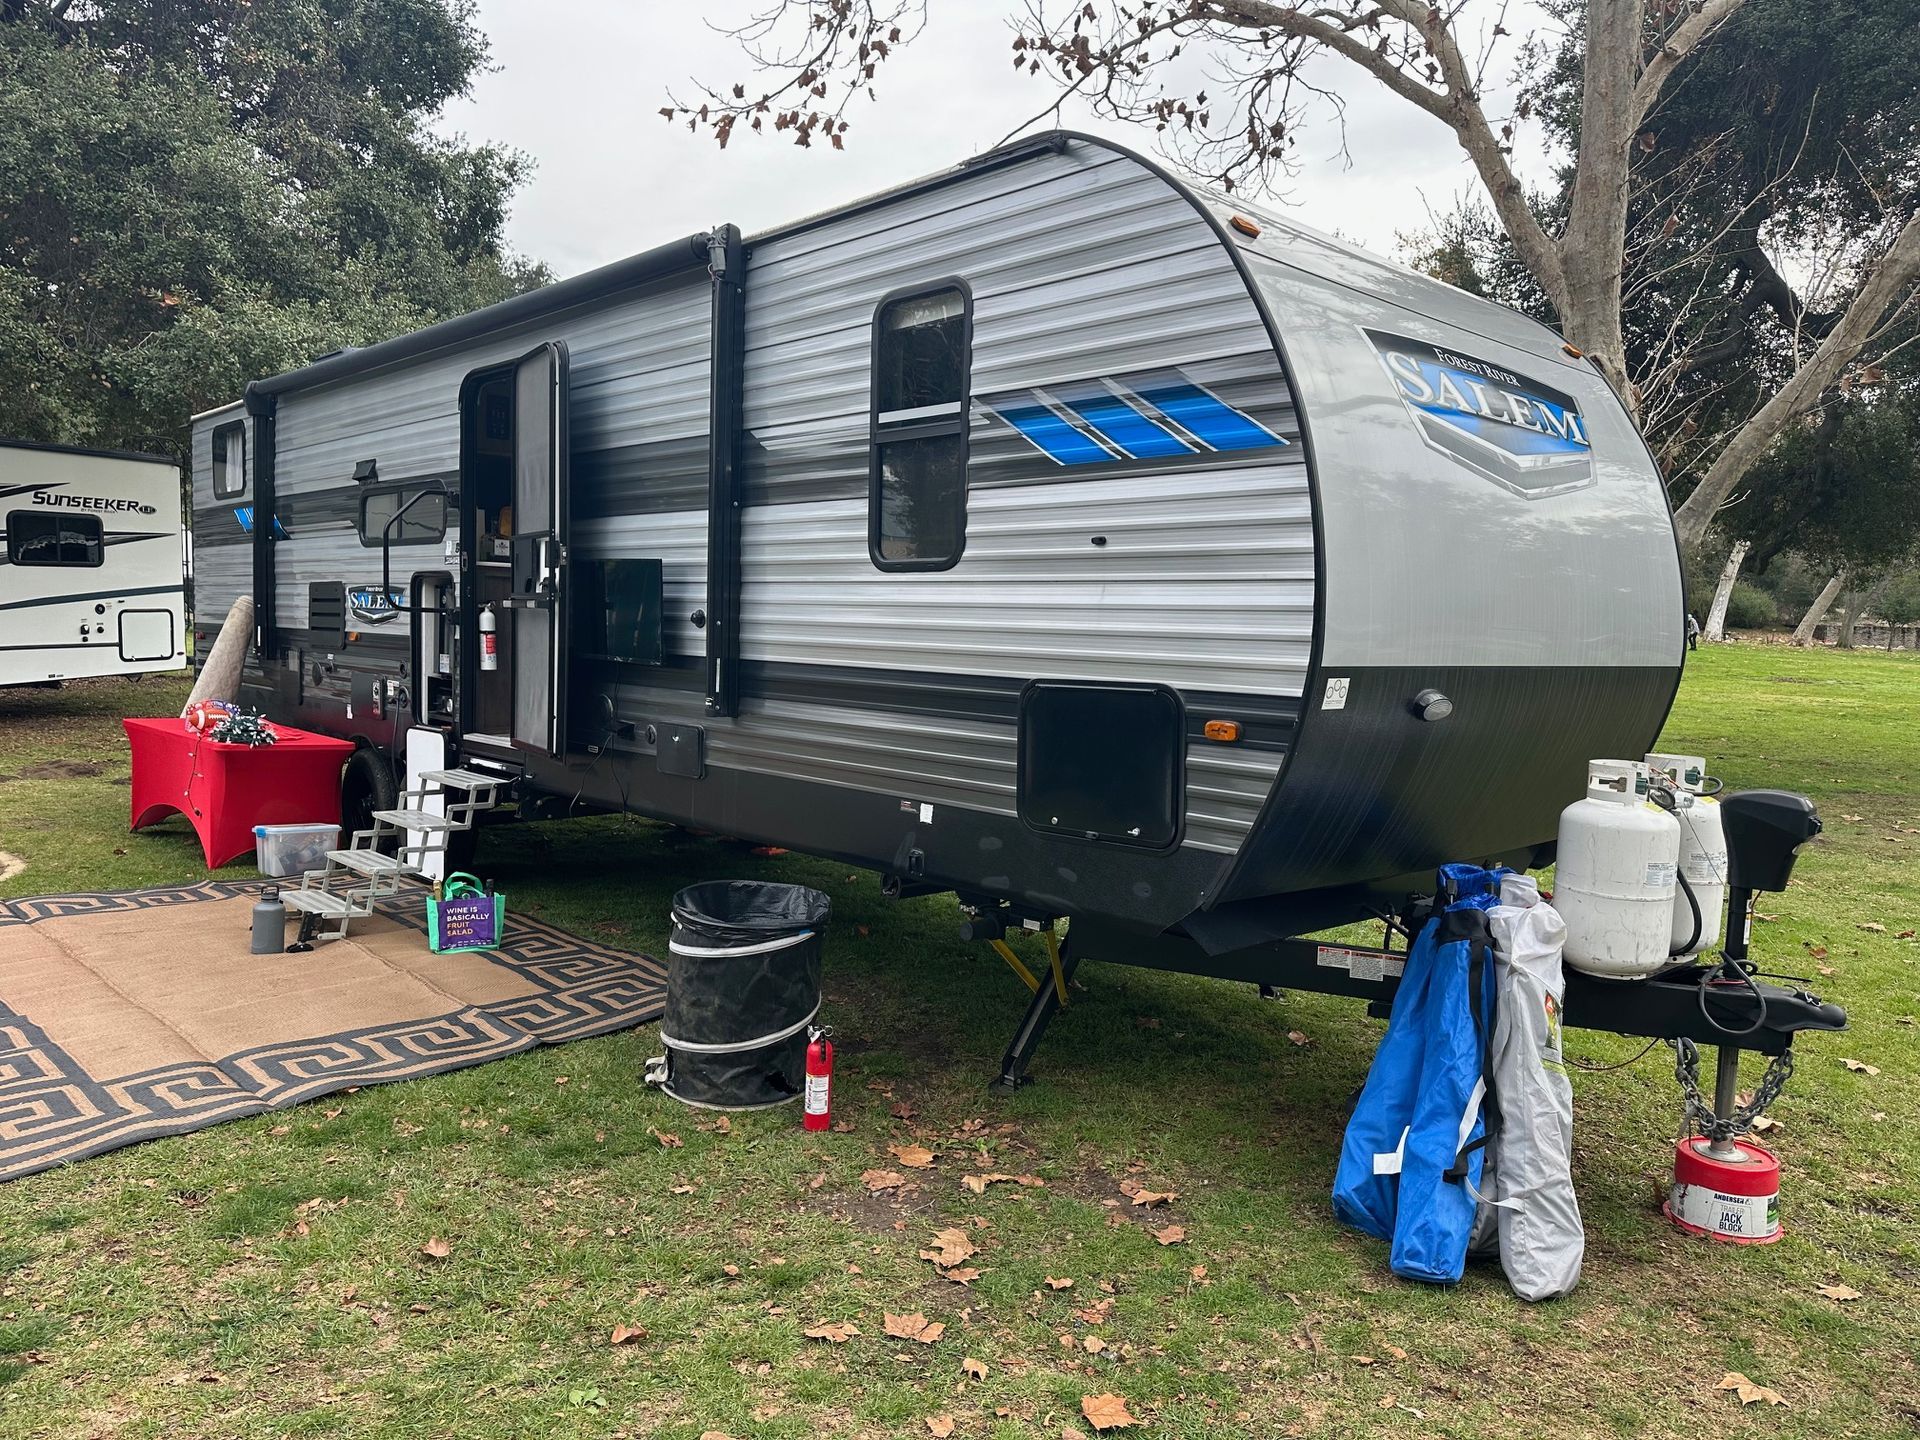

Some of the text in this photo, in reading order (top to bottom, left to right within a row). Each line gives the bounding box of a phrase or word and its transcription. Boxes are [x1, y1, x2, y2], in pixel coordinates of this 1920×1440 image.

[1433, 347, 1521, 387] FOREST RIVER
[1385, 350, 1591, 446] SALEM
[32, 491, 140, 515] SUNSEEKER
[446, 906, 468, 915] WINE
[446, 913, 490, 922] BASICALLY
[446, 921, 470, 929] FRUIT
[447, 928, 474, 937] SALAD
[1713, 1193, 1744, 1204] ANDERSEN
[1720, 1204, 1745, 1215] TRAILER
[1719, 1211, 1742, 1224] JACK
[1718, 1221, 1743, 1233] BLOCK
